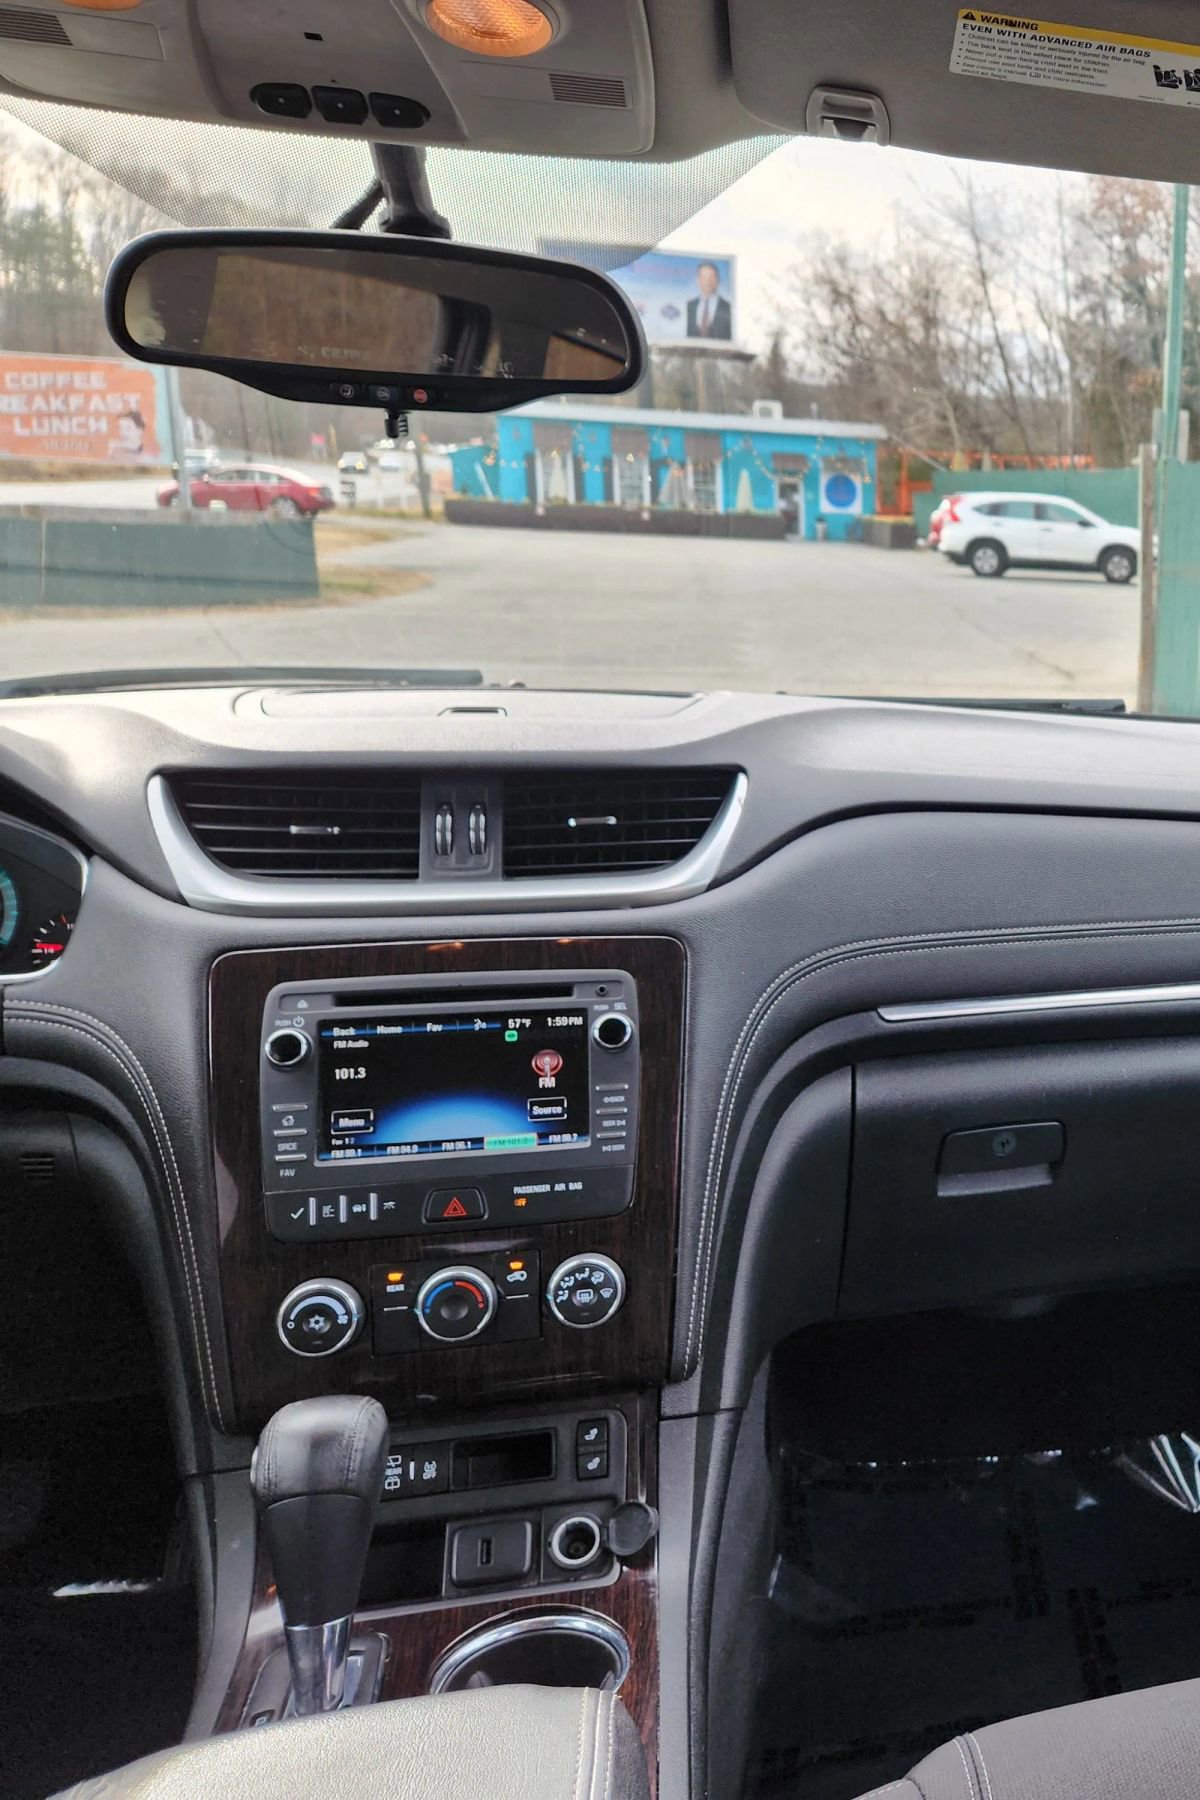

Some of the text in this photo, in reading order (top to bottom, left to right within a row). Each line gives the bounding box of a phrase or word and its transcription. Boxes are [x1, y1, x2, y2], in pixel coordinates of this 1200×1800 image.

[980, 14, 1039, 31] WARNING
[962, 23, 1152, 59] EVEN WITH ADVANCED AIR BAGS
[5, 371, 107, 391] COFFEE
[14, 416, 108, 437] LUNCH
[332, 1022, 443, 1037] Back Home Fav
[347, 1039, 369, 1048] Audio
[334, 1067, 367, 1080] 101.3
[538, 1077, 556, 1089] FM
[532, 1105, 563, 1116] Source
[338, 1117, 365, 1128] Menu
[279, 1168, 296, 1177] FAV
[513, 1182, 583, 1195] PASSENGER AIR BAG
